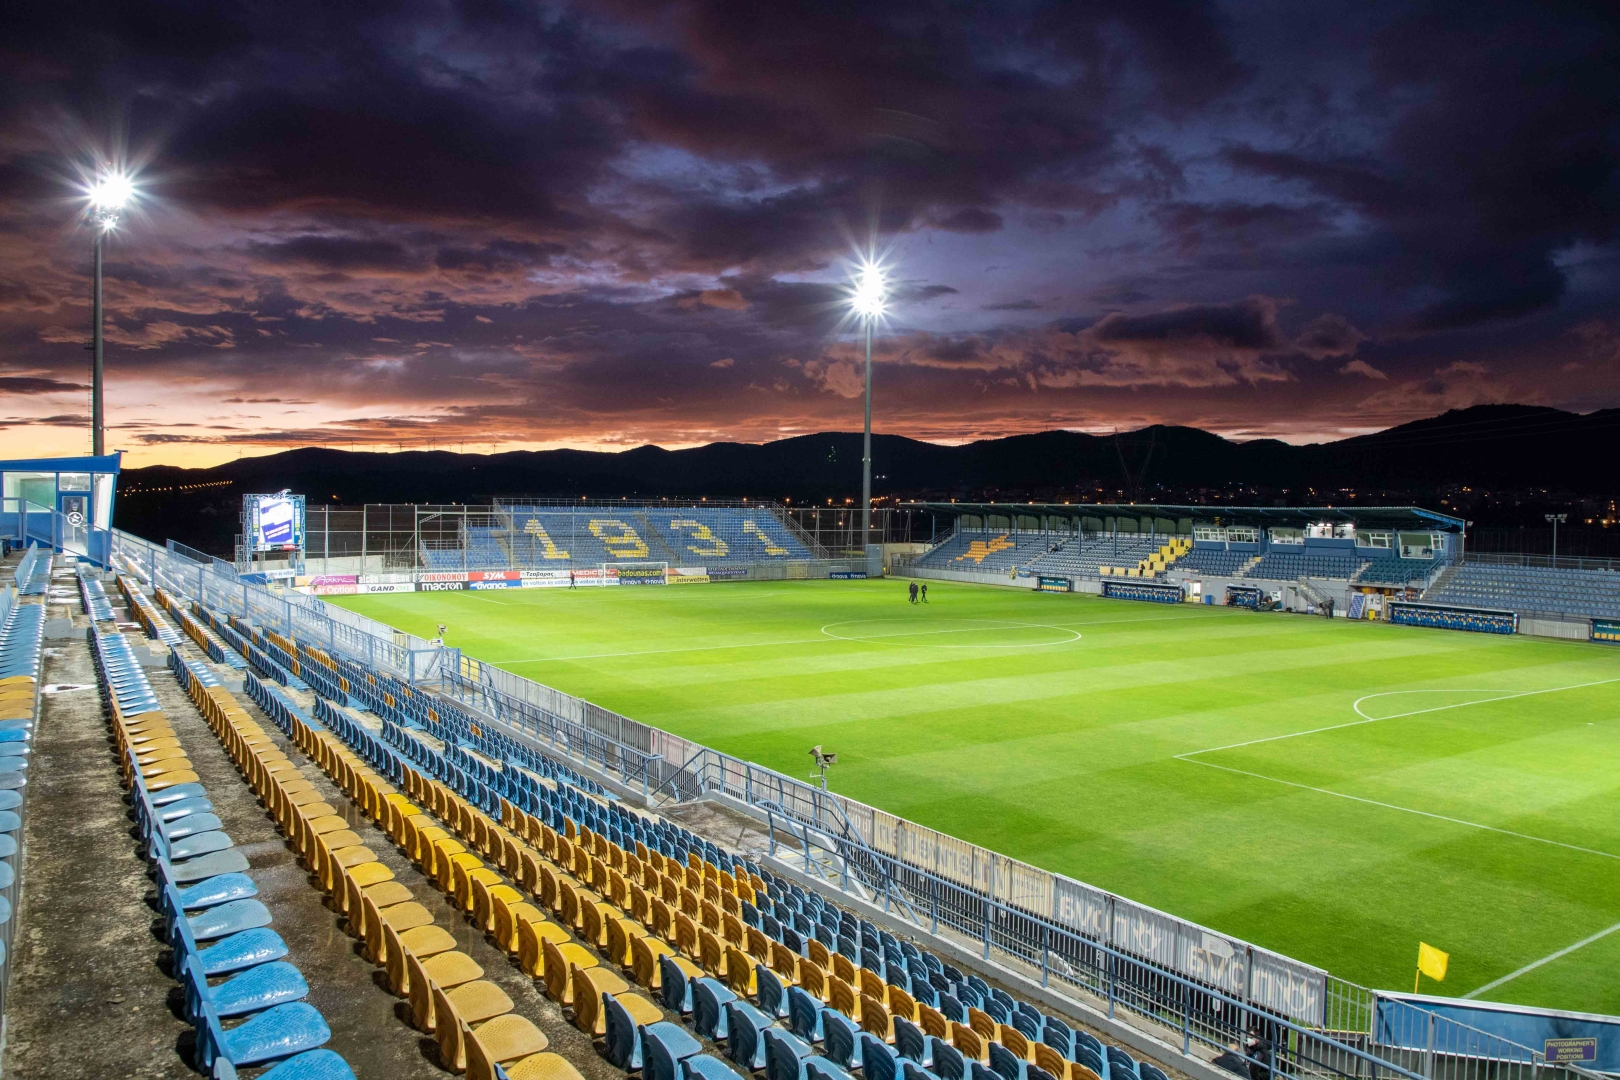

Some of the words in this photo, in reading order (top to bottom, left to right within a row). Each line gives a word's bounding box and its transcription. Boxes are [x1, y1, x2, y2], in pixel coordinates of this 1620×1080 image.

[483, 572, 506, 580] SYM
[327, 585, 355, 594] Option
[421, 582, 463, 591] macron
[476, 581, 508, 590] avance
